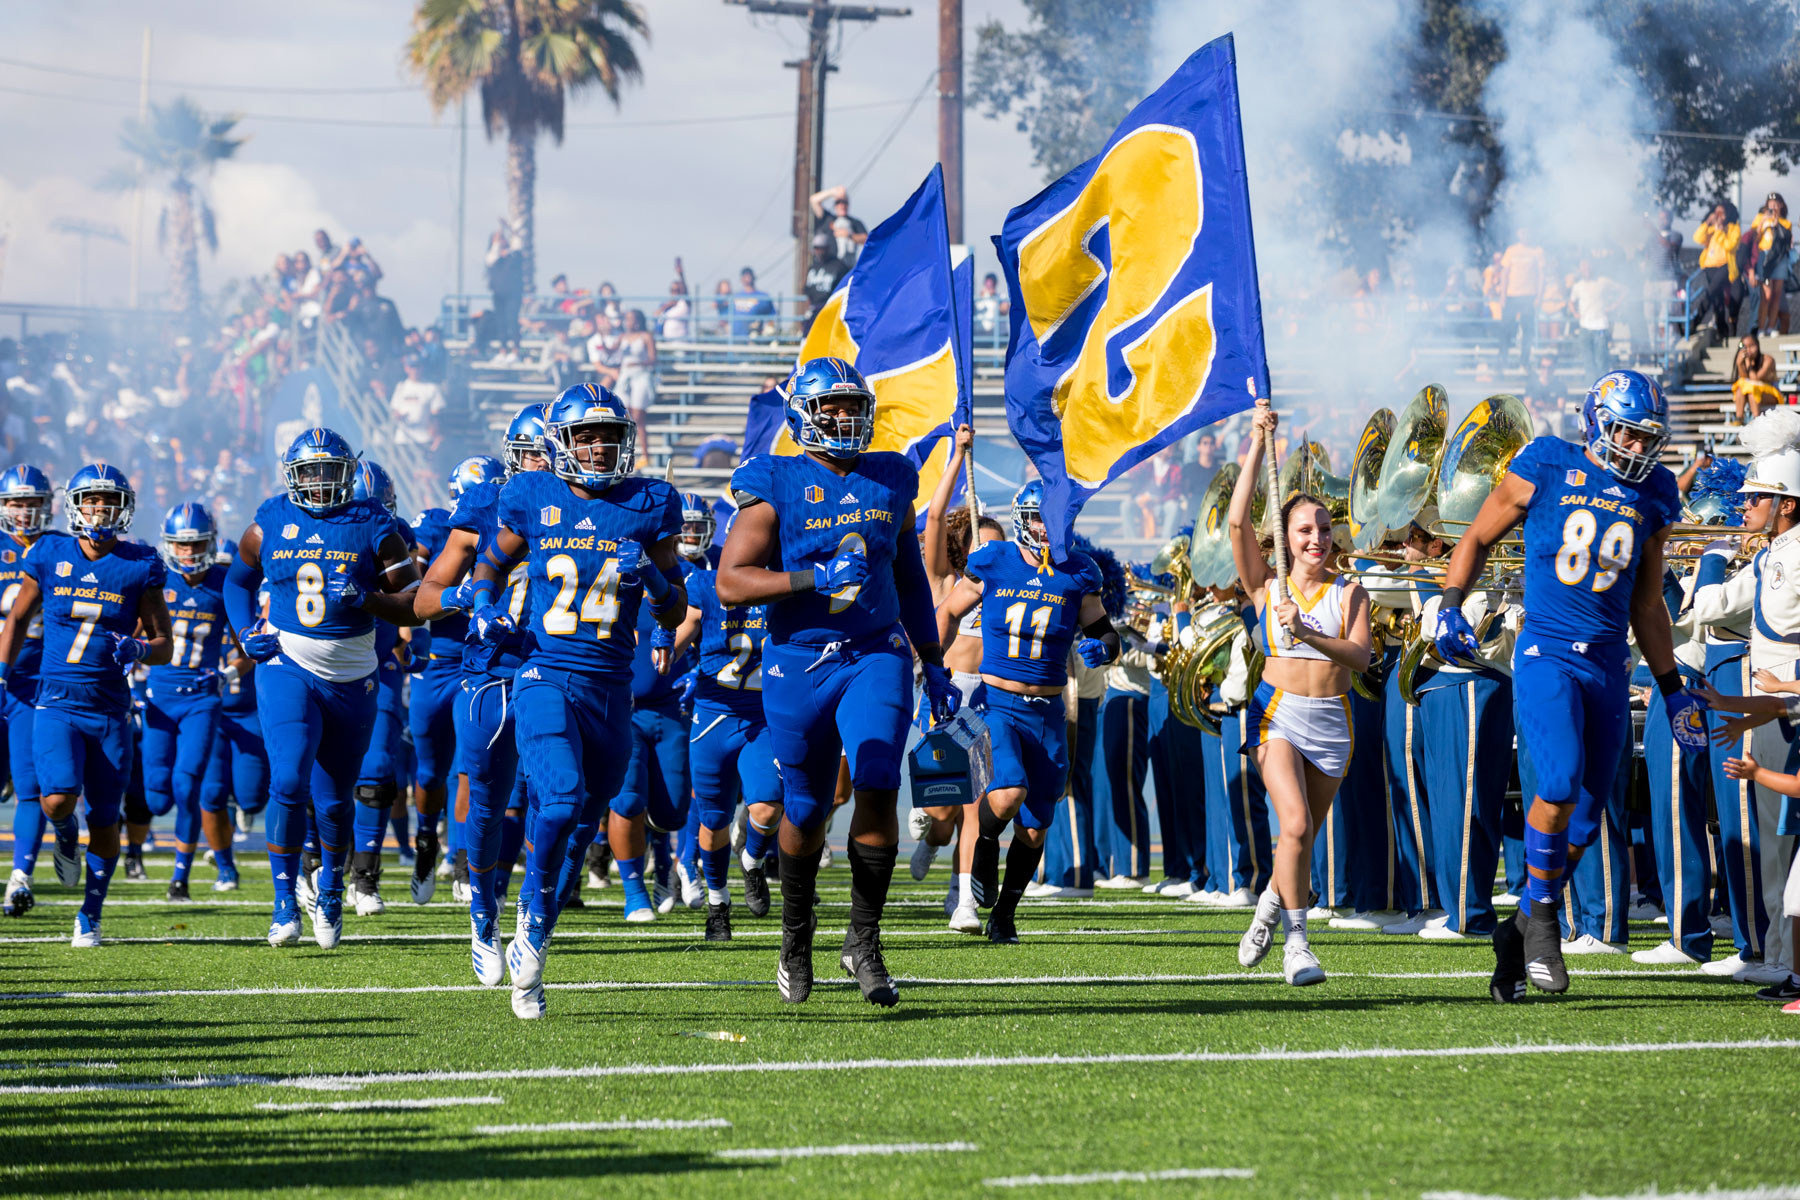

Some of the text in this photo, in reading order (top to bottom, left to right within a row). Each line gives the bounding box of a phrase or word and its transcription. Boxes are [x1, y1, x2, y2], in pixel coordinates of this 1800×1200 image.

[1560, 495, 1587, 505] SAN
[1588, 497, 1620, 512] JOSÉ
[804, 508, 893, 530] SAN JOSÉ STATE
[540, 535, 618, 553] SAN JOSÉ STA
[1555, 508, 1634, 592] 89
[272, 548, 359, 563] SAN JOSÉ STATE
[53, 586, 126, 604] SAN JOSÉ STATE
[296, 562, 326, 628] 8
[543, 554, 622, 640] 24
[994, 588, 1068, 606] SAN JOSÉ STATE
[66, 600, 103, 664] 7
[720, 621, 739, 630] SAN
[740, 617, 763, 629] JOSÉ
[1005, 601, 1053, 660] 11
[927, 786, 957, 794] SPARTANS
